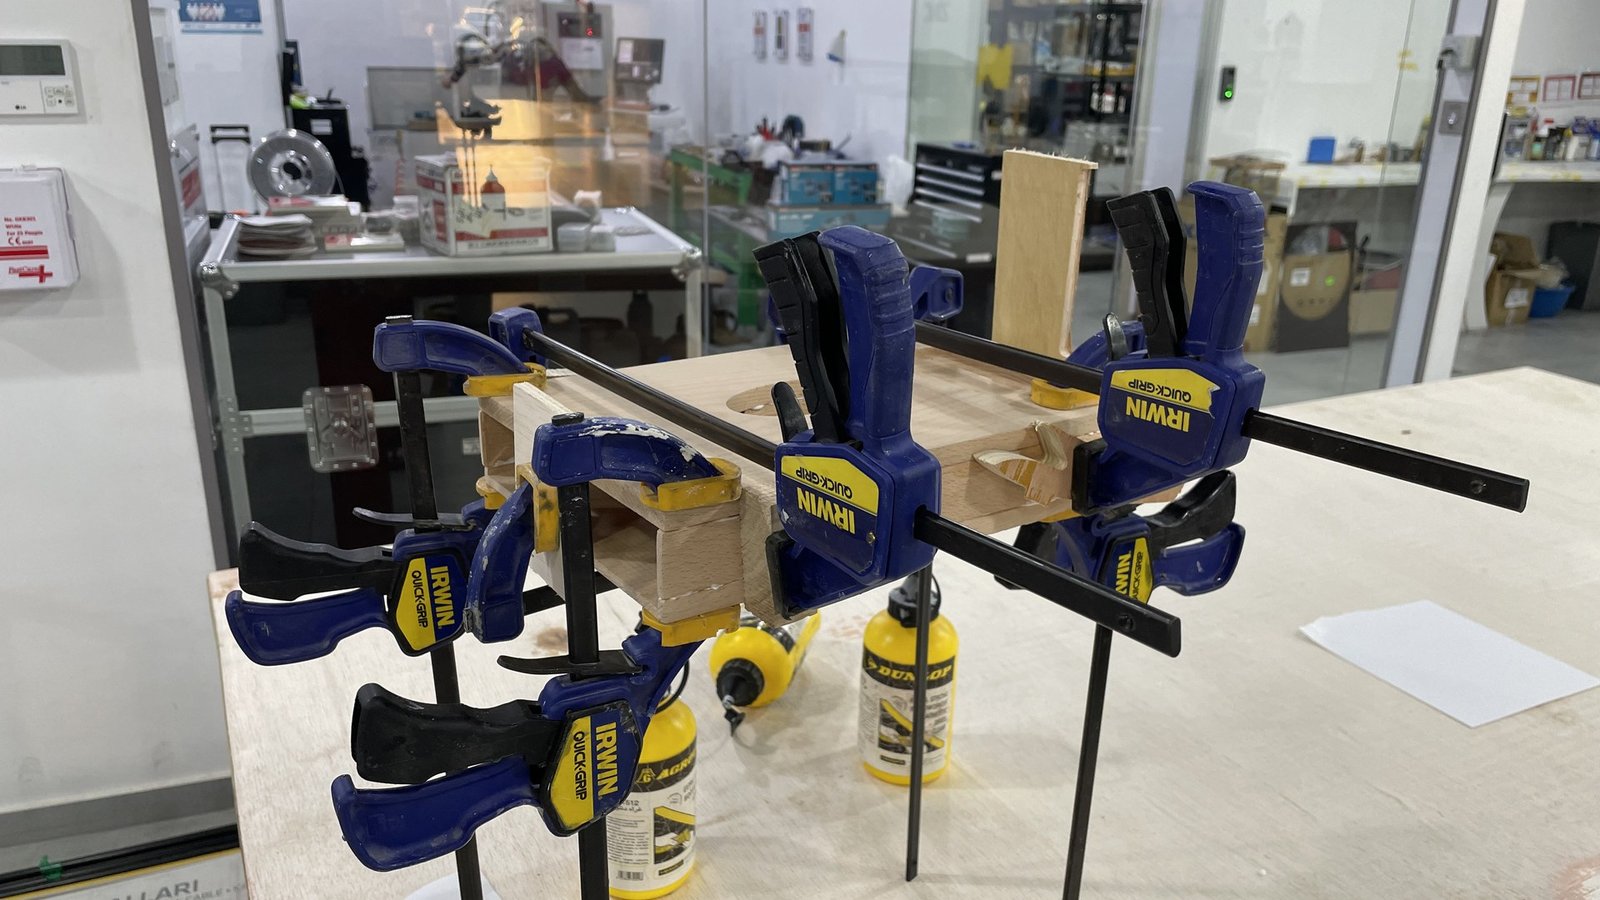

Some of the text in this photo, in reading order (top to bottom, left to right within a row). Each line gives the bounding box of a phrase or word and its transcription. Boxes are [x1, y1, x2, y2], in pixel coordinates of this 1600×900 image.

[1125, 396, 1191, 433] IRWIN
[796, 486, 856, 535] IRWIN
[1115, 551, 1132, 595] WIN
[430, 565, 455, 629] IRWIN
[878, 664, 953, 681] DUNOP
[595, 721, 619, 797] IRWIN
